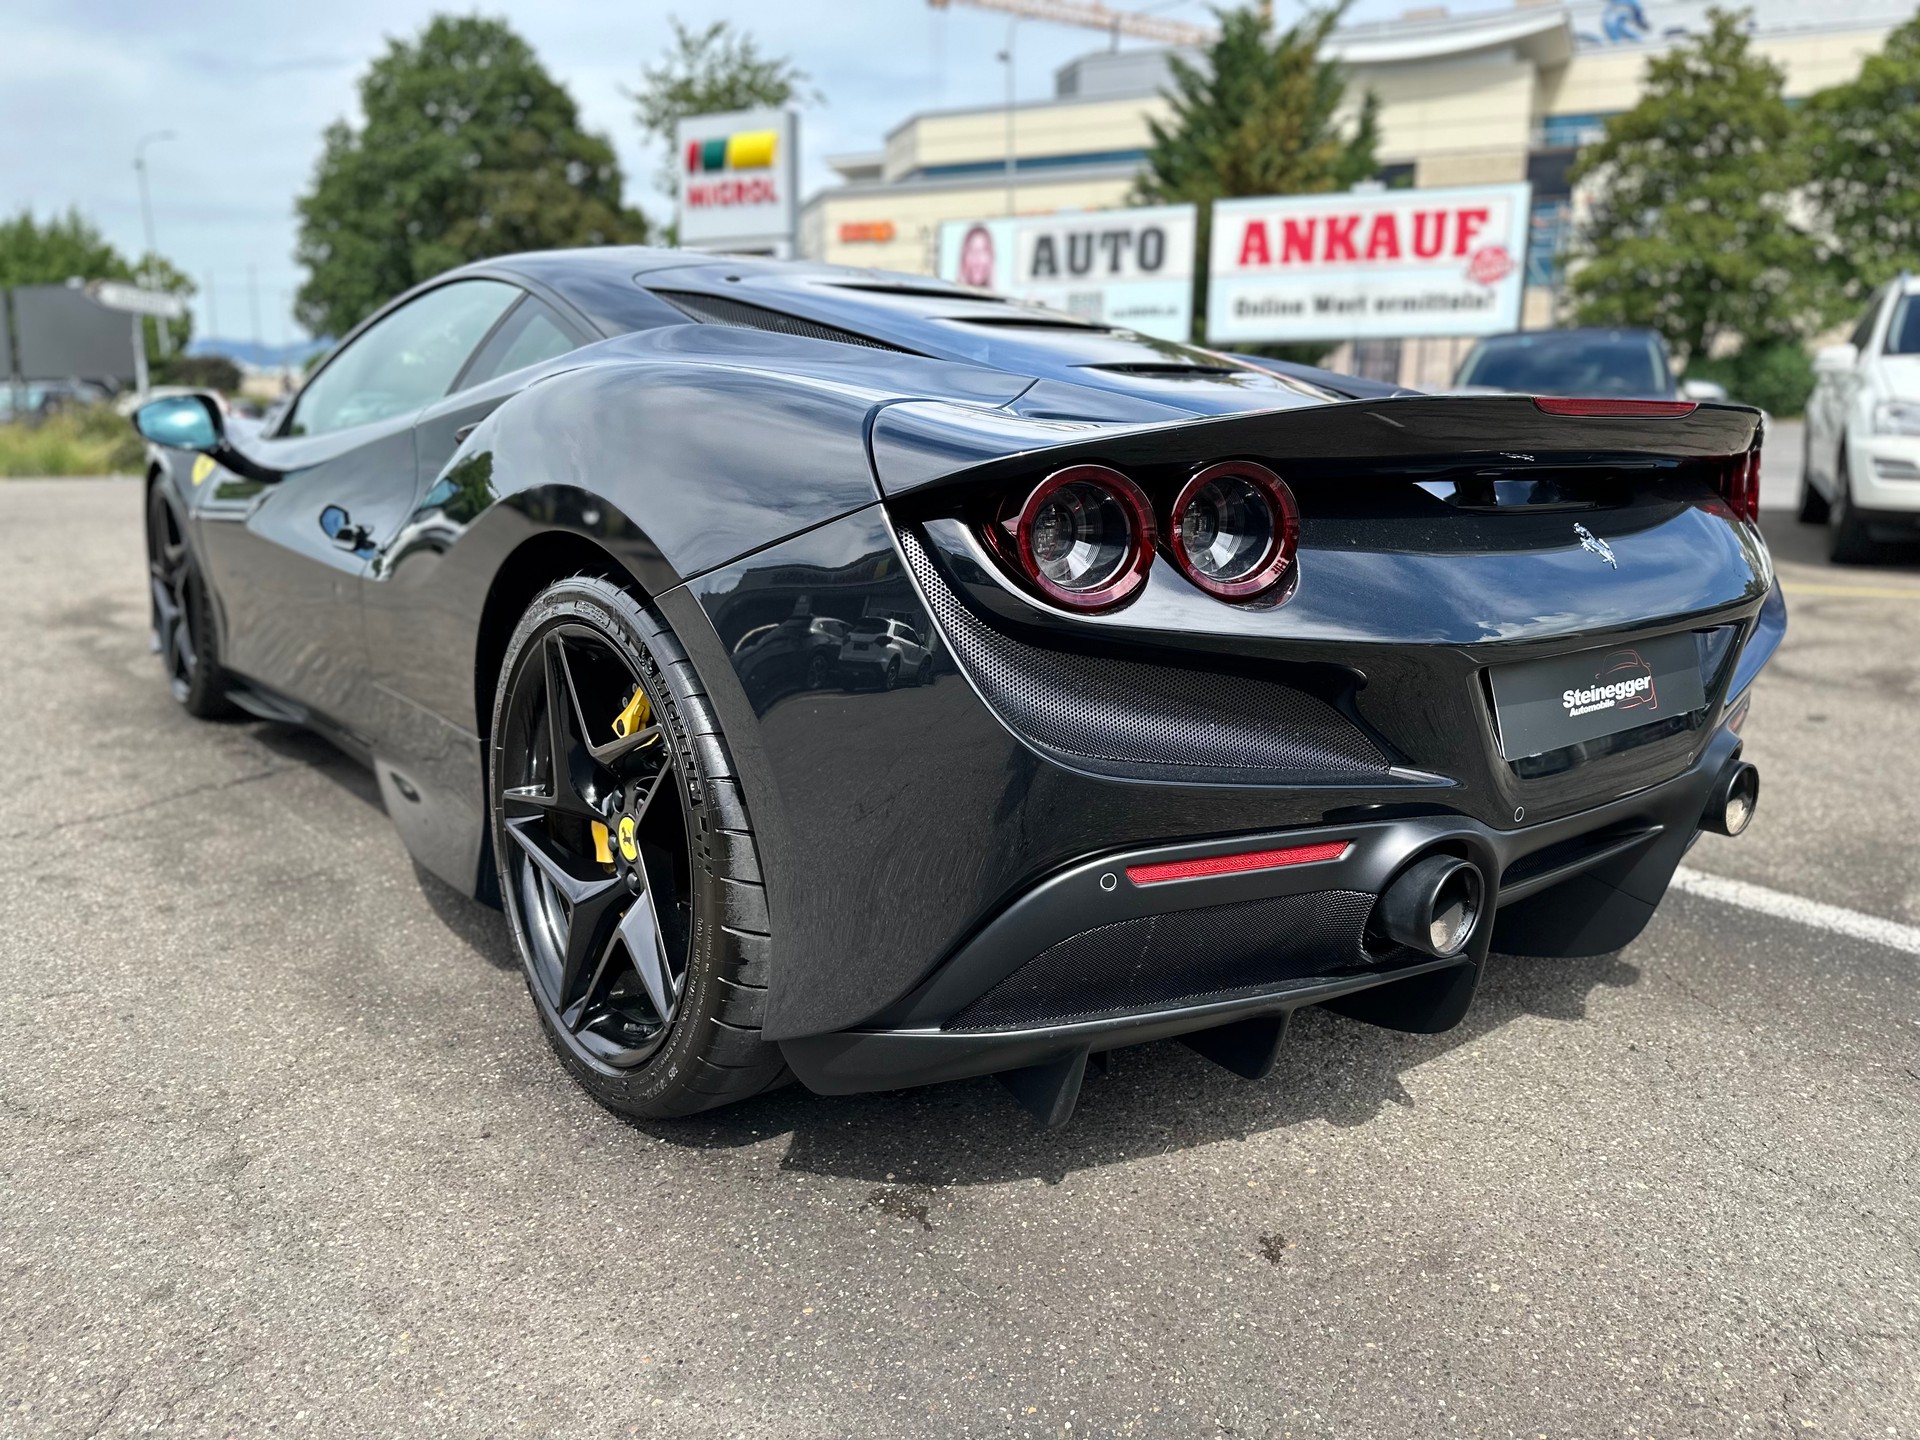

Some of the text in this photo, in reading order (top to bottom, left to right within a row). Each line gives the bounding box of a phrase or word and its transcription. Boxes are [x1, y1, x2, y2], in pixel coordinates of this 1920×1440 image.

[687, 180, 777, 207] MIGROL
[1031, 227, 1166, 276] AUTO
[1239, 208, 1489, 266] ANKAUF
[1235, 297, 1304, 317] Online
[1314, 294, 1367, 314] Wert
[1563, 676, 1651, 708] Steinegger
[1569, 699, 1615, 717] Automobile
